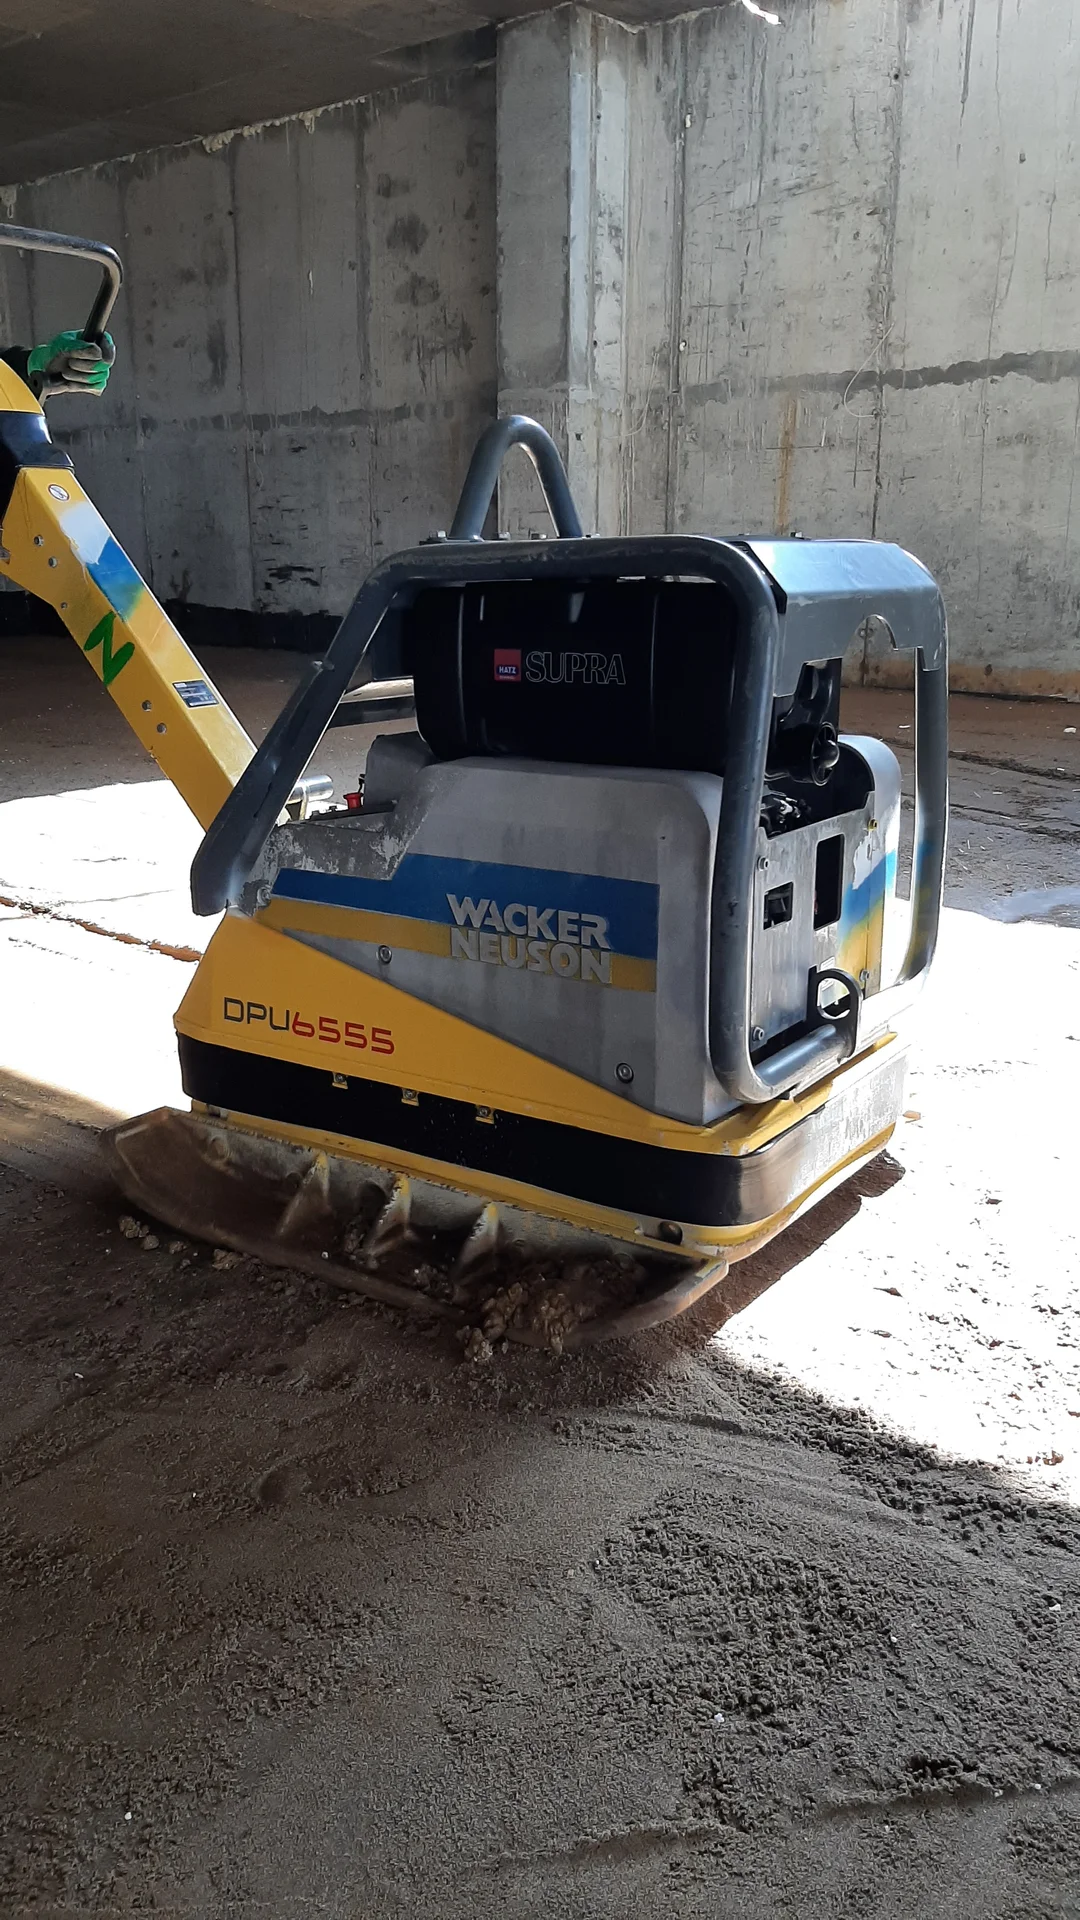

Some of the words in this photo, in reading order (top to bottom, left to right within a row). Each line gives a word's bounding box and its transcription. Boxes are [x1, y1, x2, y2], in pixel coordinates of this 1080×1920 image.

[499, 666, 516, 674] HATZ
[526, 651, 626, 685] SUPRA
[446, 893, 611, 950] WACKER
[451, 927, 612, 984] NEUSON
[224, 997, 395, 1055] DPU6555
